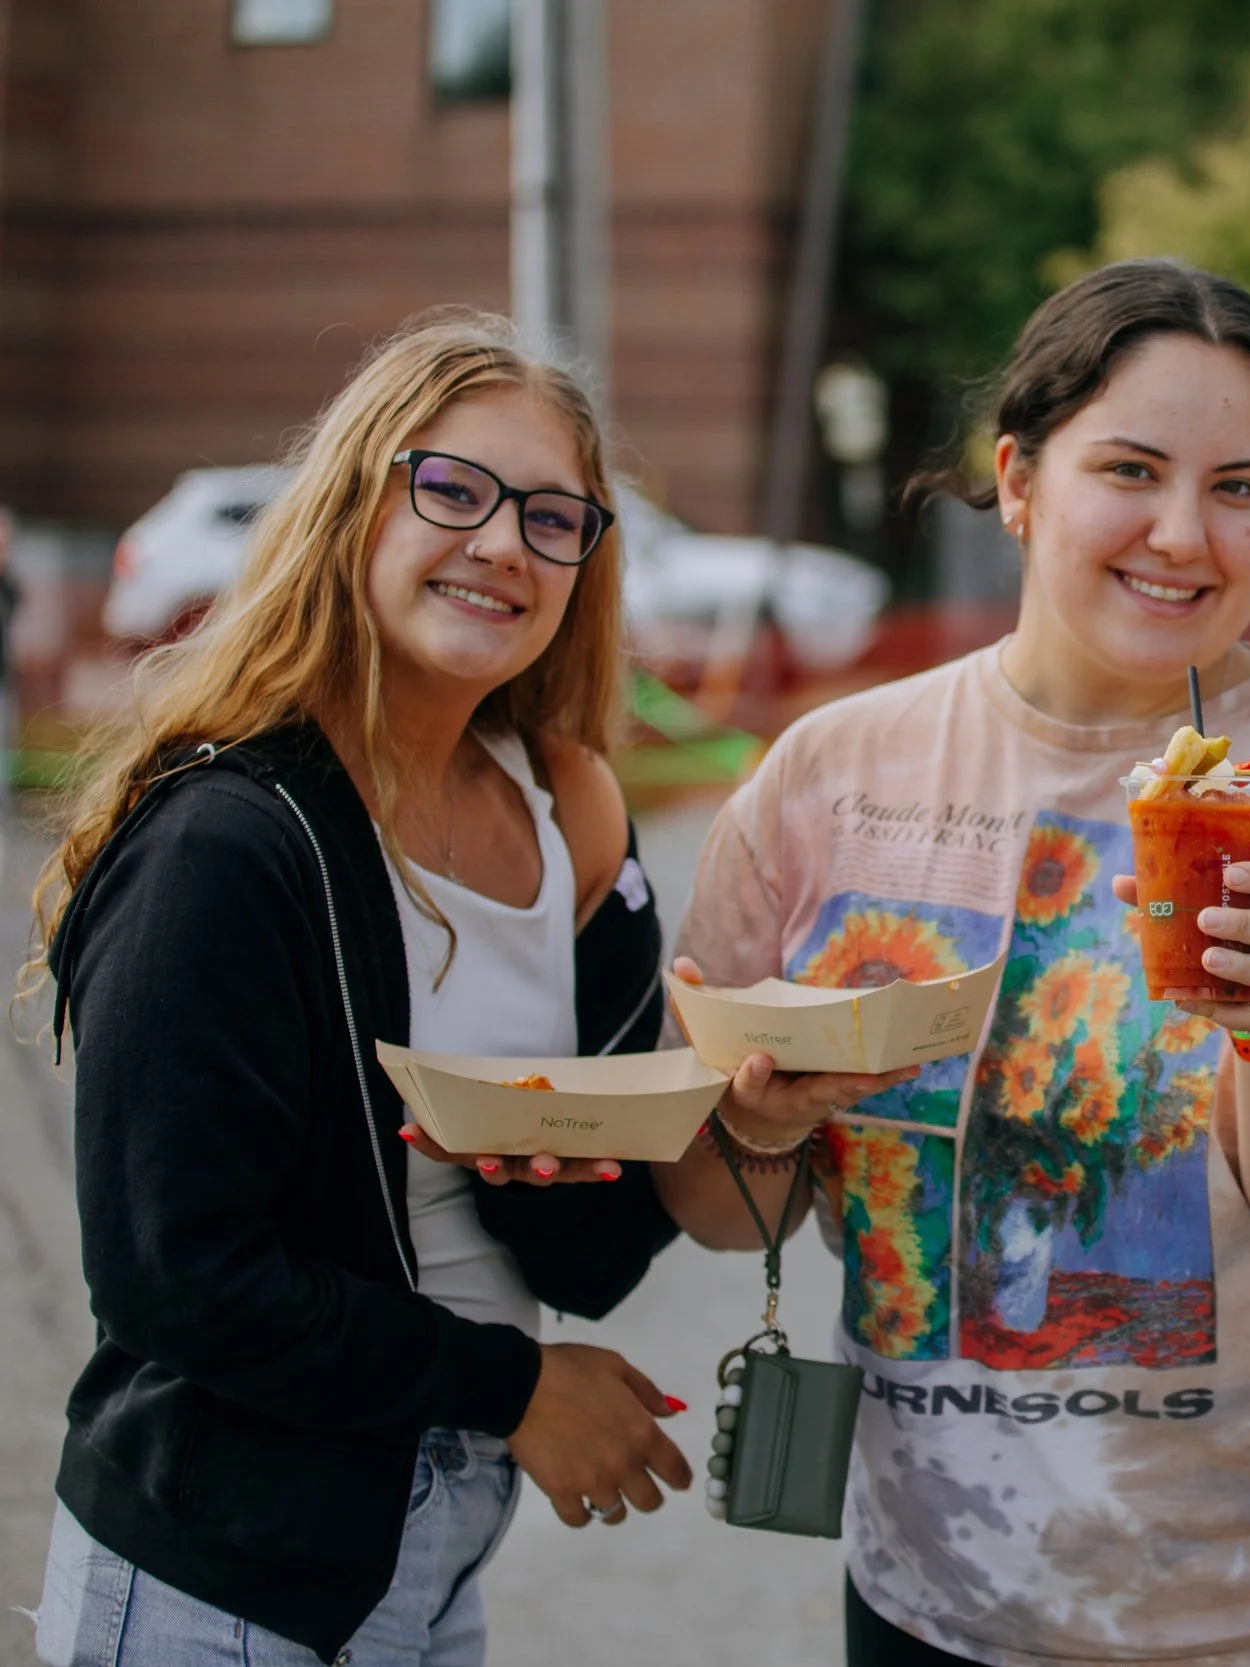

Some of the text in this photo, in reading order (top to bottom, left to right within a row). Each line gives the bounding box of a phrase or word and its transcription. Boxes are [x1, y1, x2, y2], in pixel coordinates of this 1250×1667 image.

[832, 792, 1027, 833] Claude Mont
[743, 1032, 792, 1046] NoTree
[540, 1116, 600, 1130] NoTree
